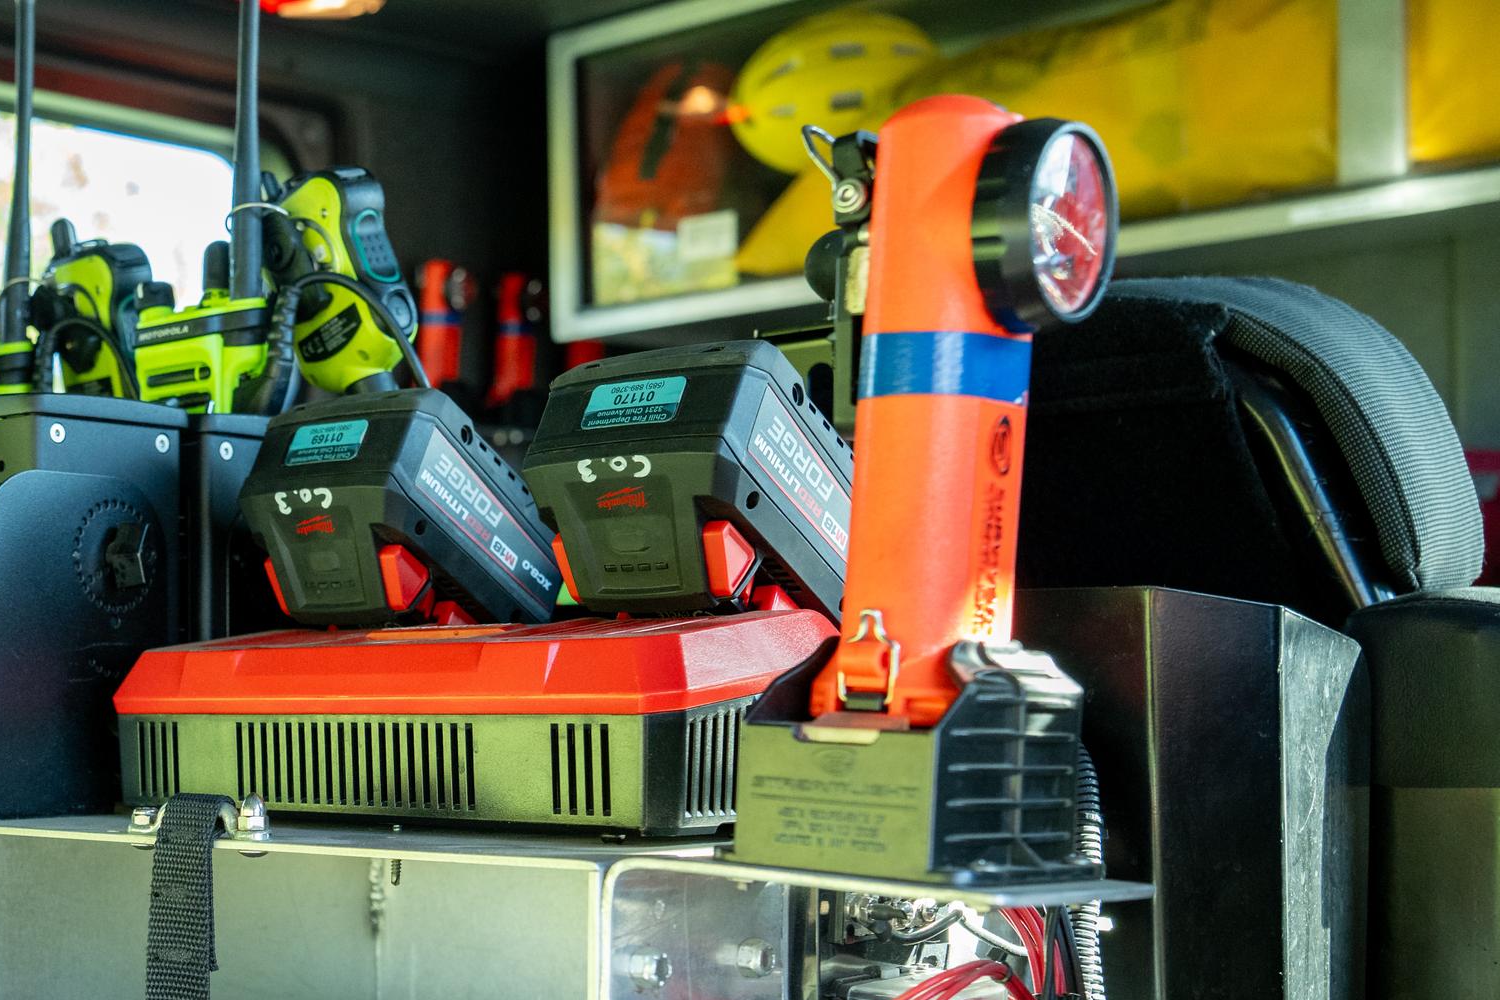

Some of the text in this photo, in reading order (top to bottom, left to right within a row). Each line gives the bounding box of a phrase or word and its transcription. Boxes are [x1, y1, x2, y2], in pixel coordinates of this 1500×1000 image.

[613, 391, 655, 406] 01170
[596, 408, 625, 418] Avenue
[645, 405, 663, 413] 3231
[587, 416, 631, 427] Department
[632, 414, 648, 423] Fire
[311, 432, 344, 445] 01169
[766, 415, 835, 502] FORGE
[433, 453, 504, 528] FORGE
